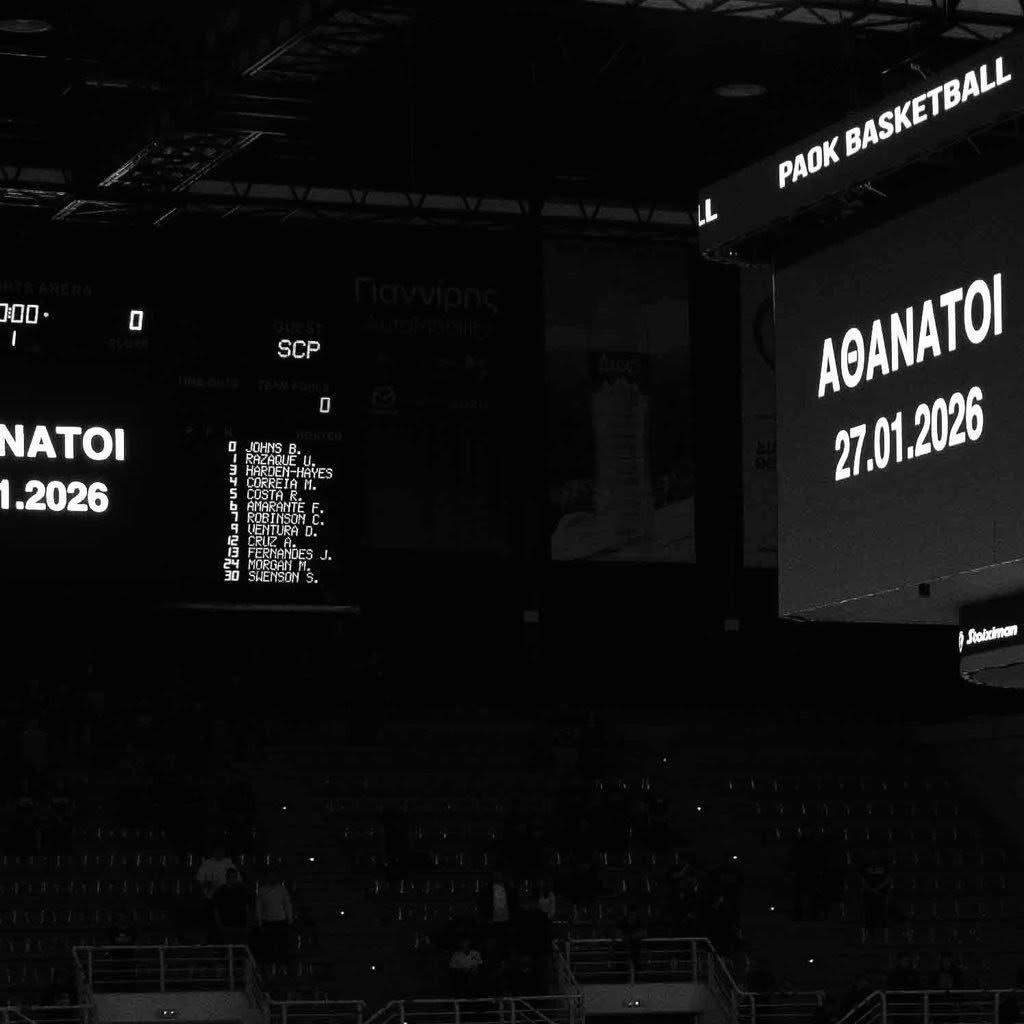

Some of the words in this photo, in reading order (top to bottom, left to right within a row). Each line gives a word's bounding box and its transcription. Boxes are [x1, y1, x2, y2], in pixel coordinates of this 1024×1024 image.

[778, 135, 840, 189] PAOK
[845, 56, 1012, 157] BASKETBALL
[128, 309, 144, 331] 0
[817, 272, 1003, 398] ΑΘΑΝΑΤΟΙ
[277, 338, 321, 360] SCP
[319, 396, 331, 414] 0
[833, 386, 984, 482] 27.01.2026
[228, 441, 237, 452] 0
[245, 441, 282, 453] JOHNS
[289, 443, 301, 454] B.
[232, 453, 238, 463] 1
[245, 453, 298, 466] RAZAQUE
[303, 455, 316, 467] U.
[229, 464, 238, 476] 3
[245, 464, 334, 479] HARDEN-HAYES
[229, 476, 238, 487] 4
[246, 477, 298, 489] CORREIA
[304, 479, 317, 491] M.
[229, 488, 238, 499] 5
[246, 488, 284, 501] COSTA
[289, 490, 302, 501] R.
[229, 500, 238, 511] 6
[246, 500, 306, 513] AMARANTE
[311, 502, 324, 514] F.
[230, 511, 239, 522] 7
[246, 512, 306, 525] ROBINSON
[311, 513, 325, 526] C.
[230, 523, 239, 534] 9
[247, 523, 299, 537] VENTURA
[305, 525, 318, 537] D.
[227, 535, 239, 546] 12
[247, 535, 278, 547] CRUZ
[283, 536, 297, 548] A.
[227, 547, 240, 558] 13
[247, 547, 314, 560] FERNANDES
[319, 549, 333, 561] J.
[223, 558, 240, 570] 24
[247, 559, 292, 571] MORGAN
[298, 560, 311, 572] M.
[224, 570, 240, 582] 30
[248, 570, 300, 583] SWENSON
[305, 572, 319, 584] S.
[965, 624, 1019, 645] Stoiximan
